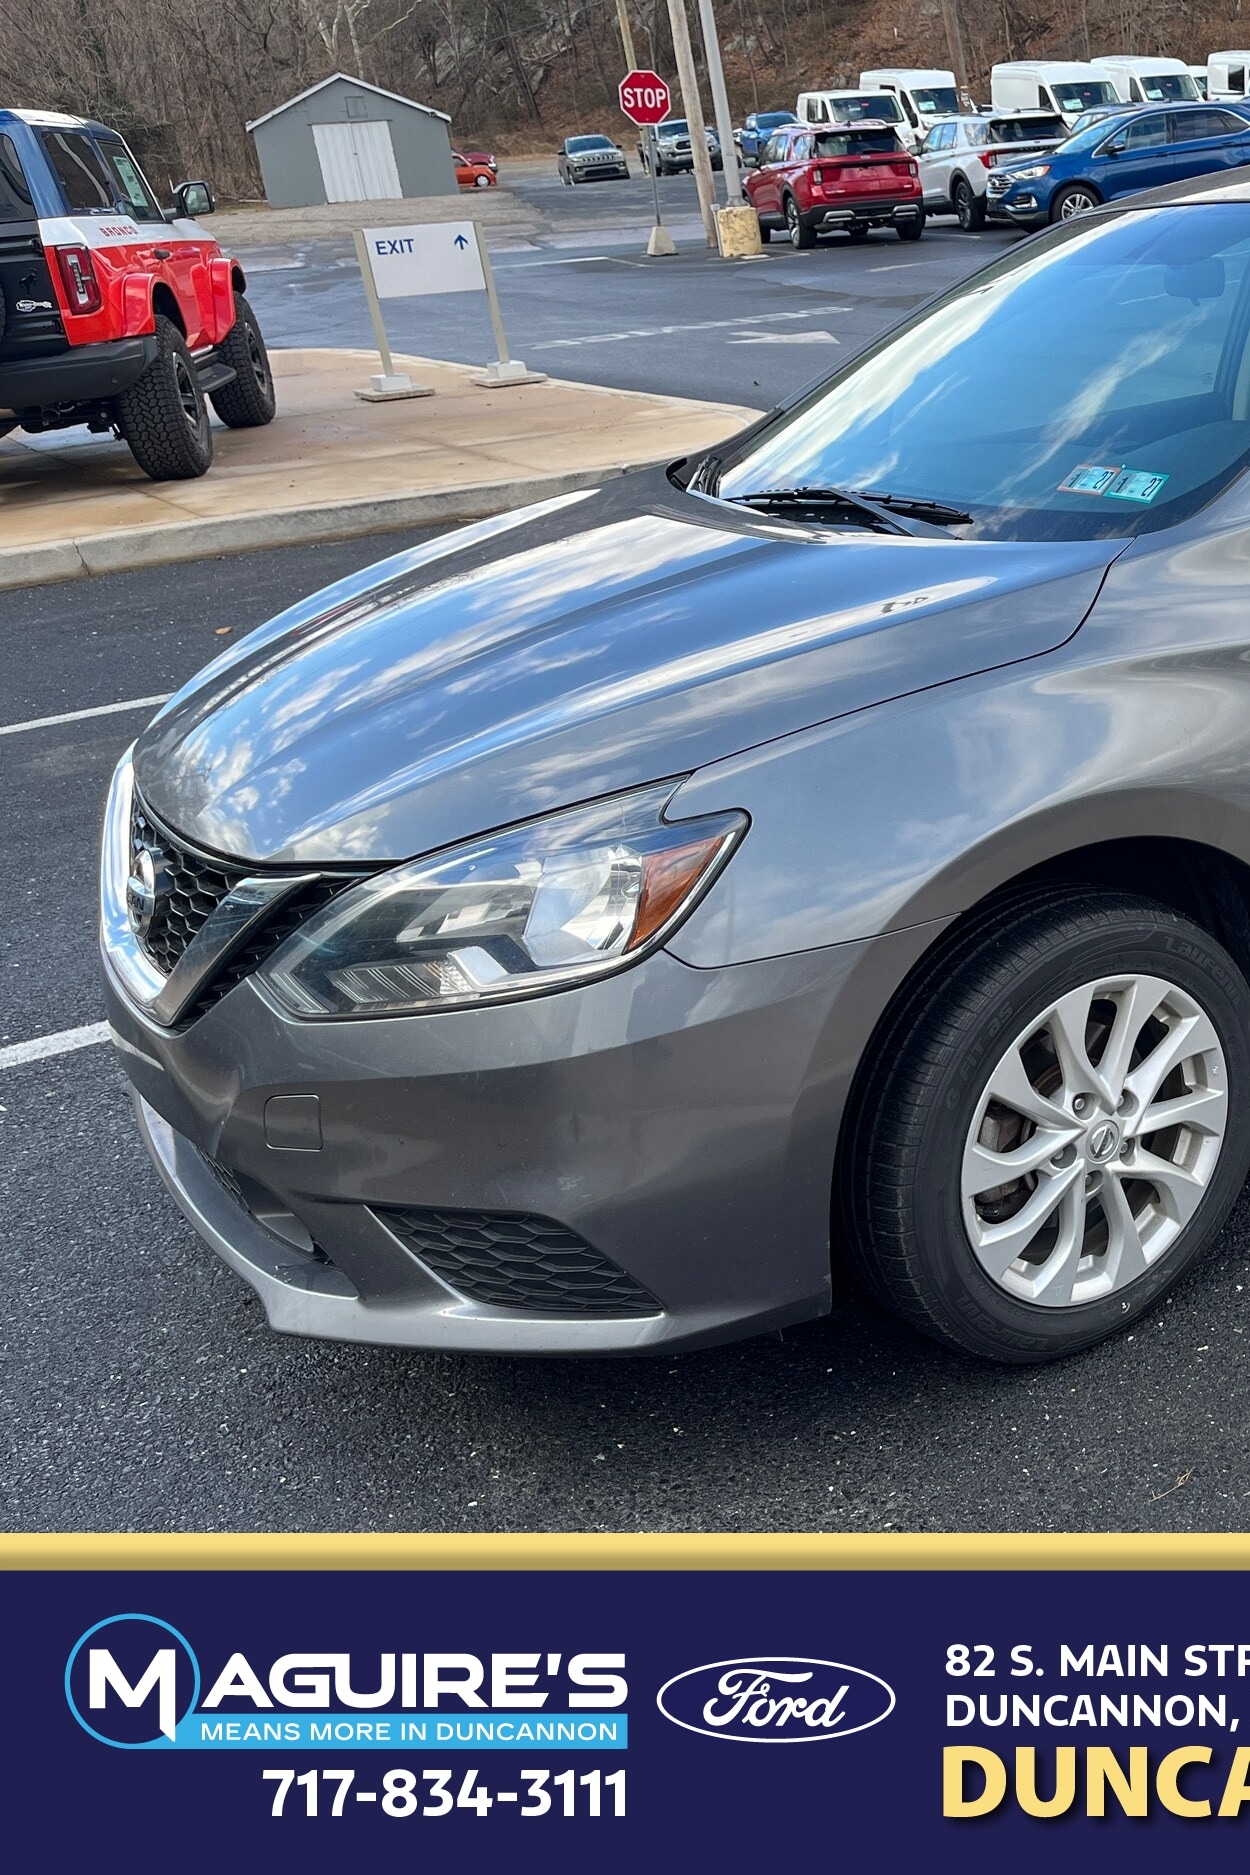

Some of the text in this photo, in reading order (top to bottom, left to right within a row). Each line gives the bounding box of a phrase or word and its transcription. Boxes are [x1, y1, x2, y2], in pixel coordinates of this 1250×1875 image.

[623, 87, 666, 108] STOP
[98, 226, 139, 236] BRONCO
[375, 239, 414, 255] EXIT
[1093, 471, 1114, 490] 27
[1141, 477, 1163, 498] 27
